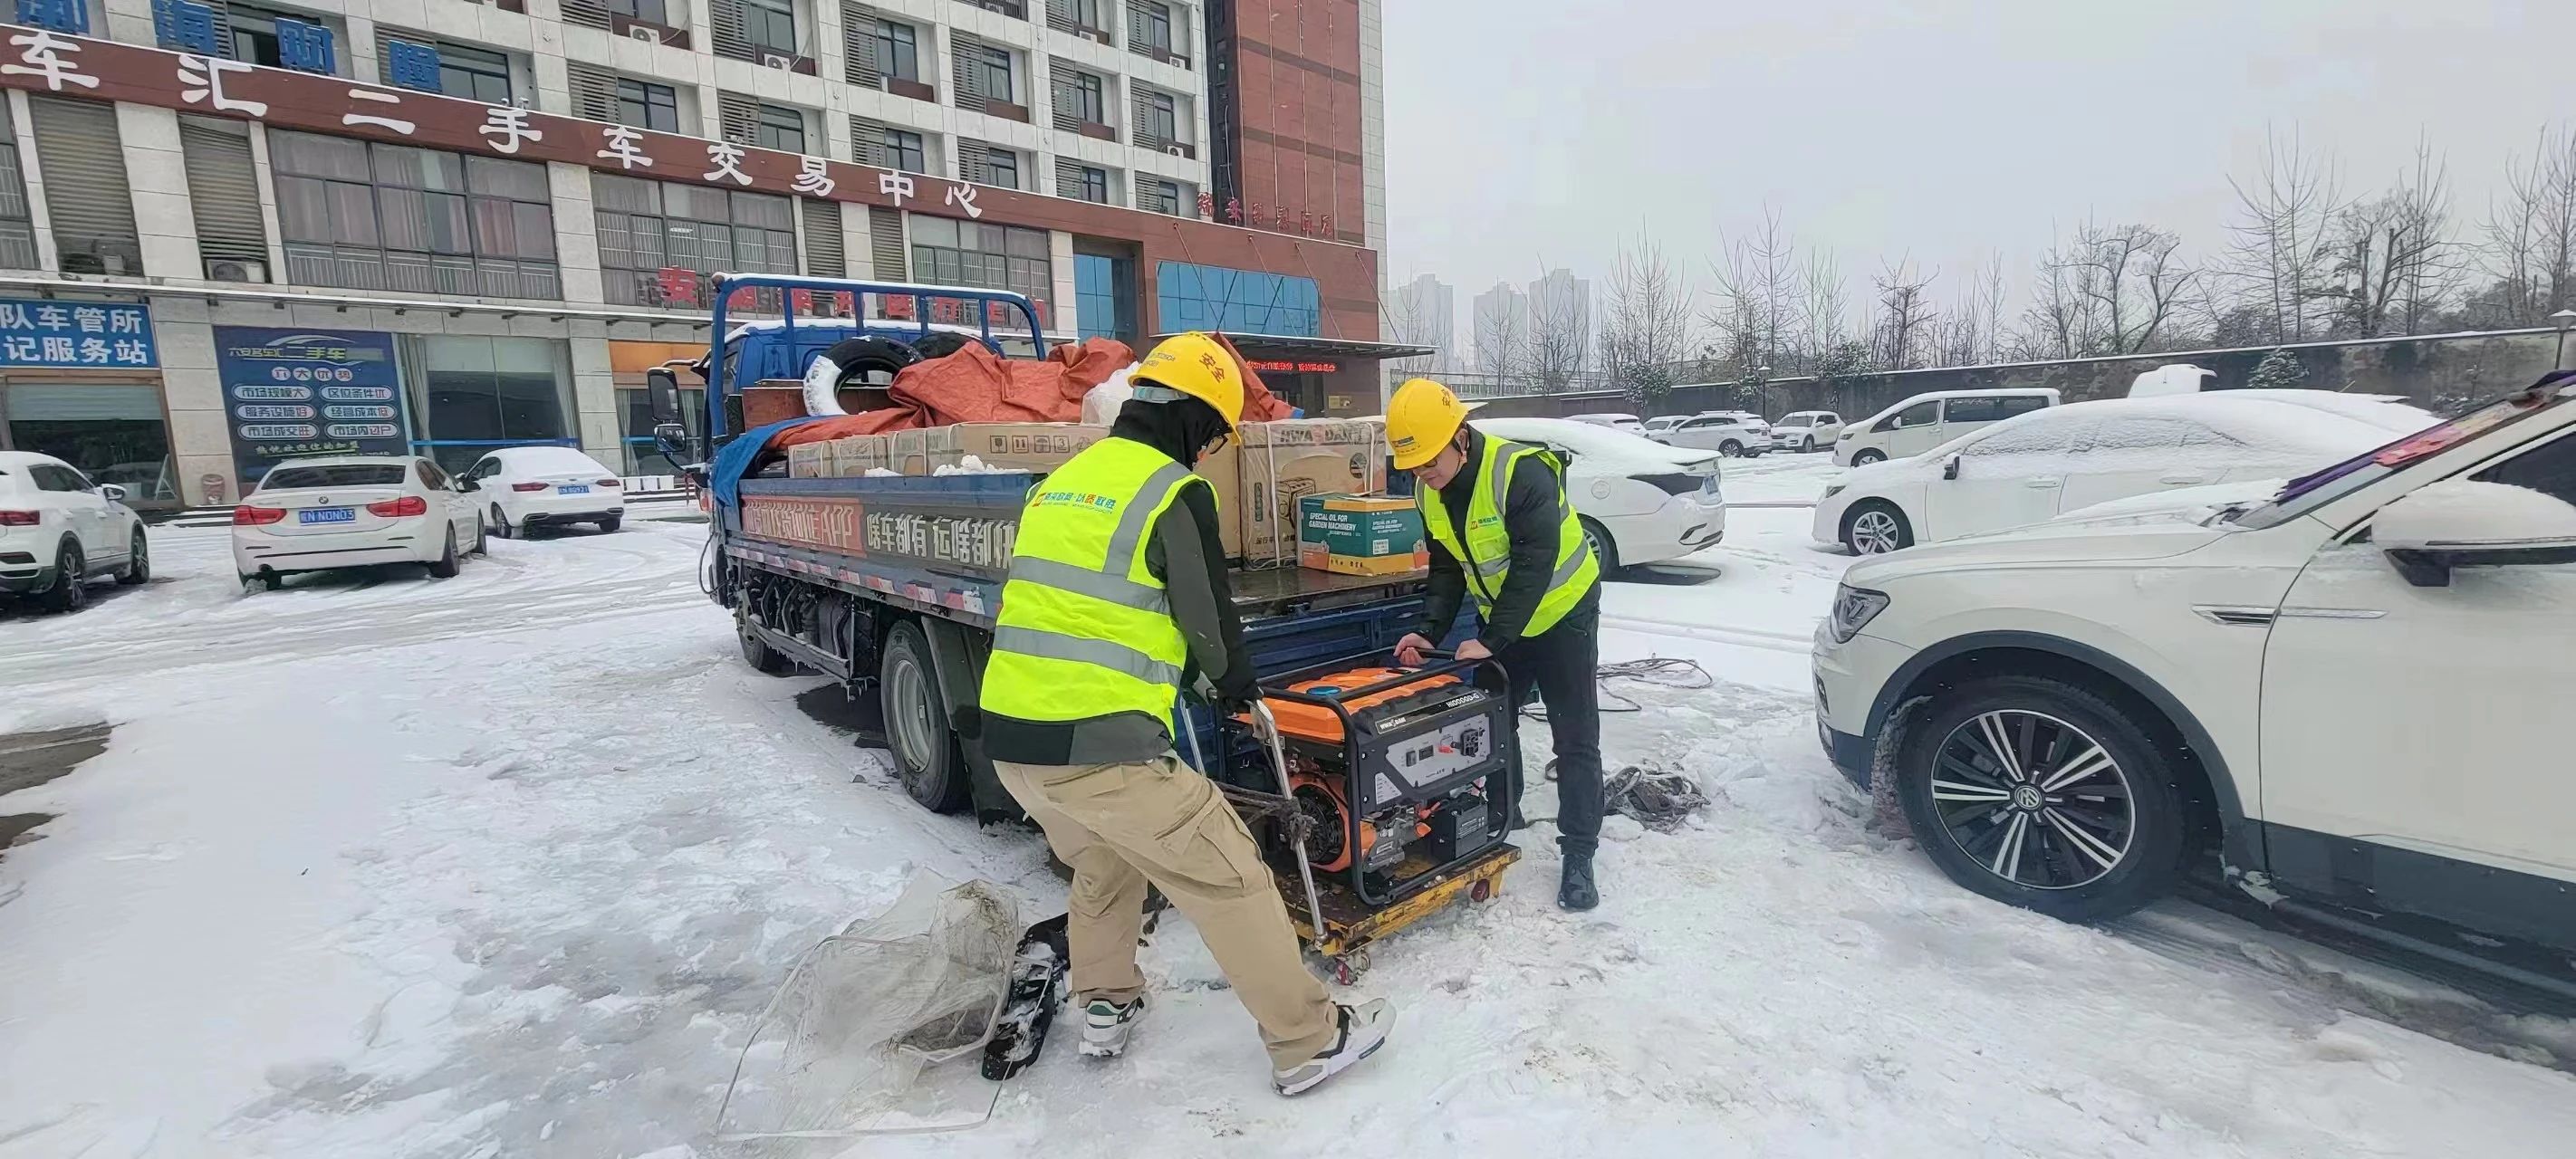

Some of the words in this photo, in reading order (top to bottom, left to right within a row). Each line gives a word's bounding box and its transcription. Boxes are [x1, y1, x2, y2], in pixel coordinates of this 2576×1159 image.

[0, 31, 983, 218] 车汇二手车交易中心
[0, 303, 143, 334] 队车管所
[0, 335, 148, 364] 记服务站
[1337, 514, 1348, 522] FOR
